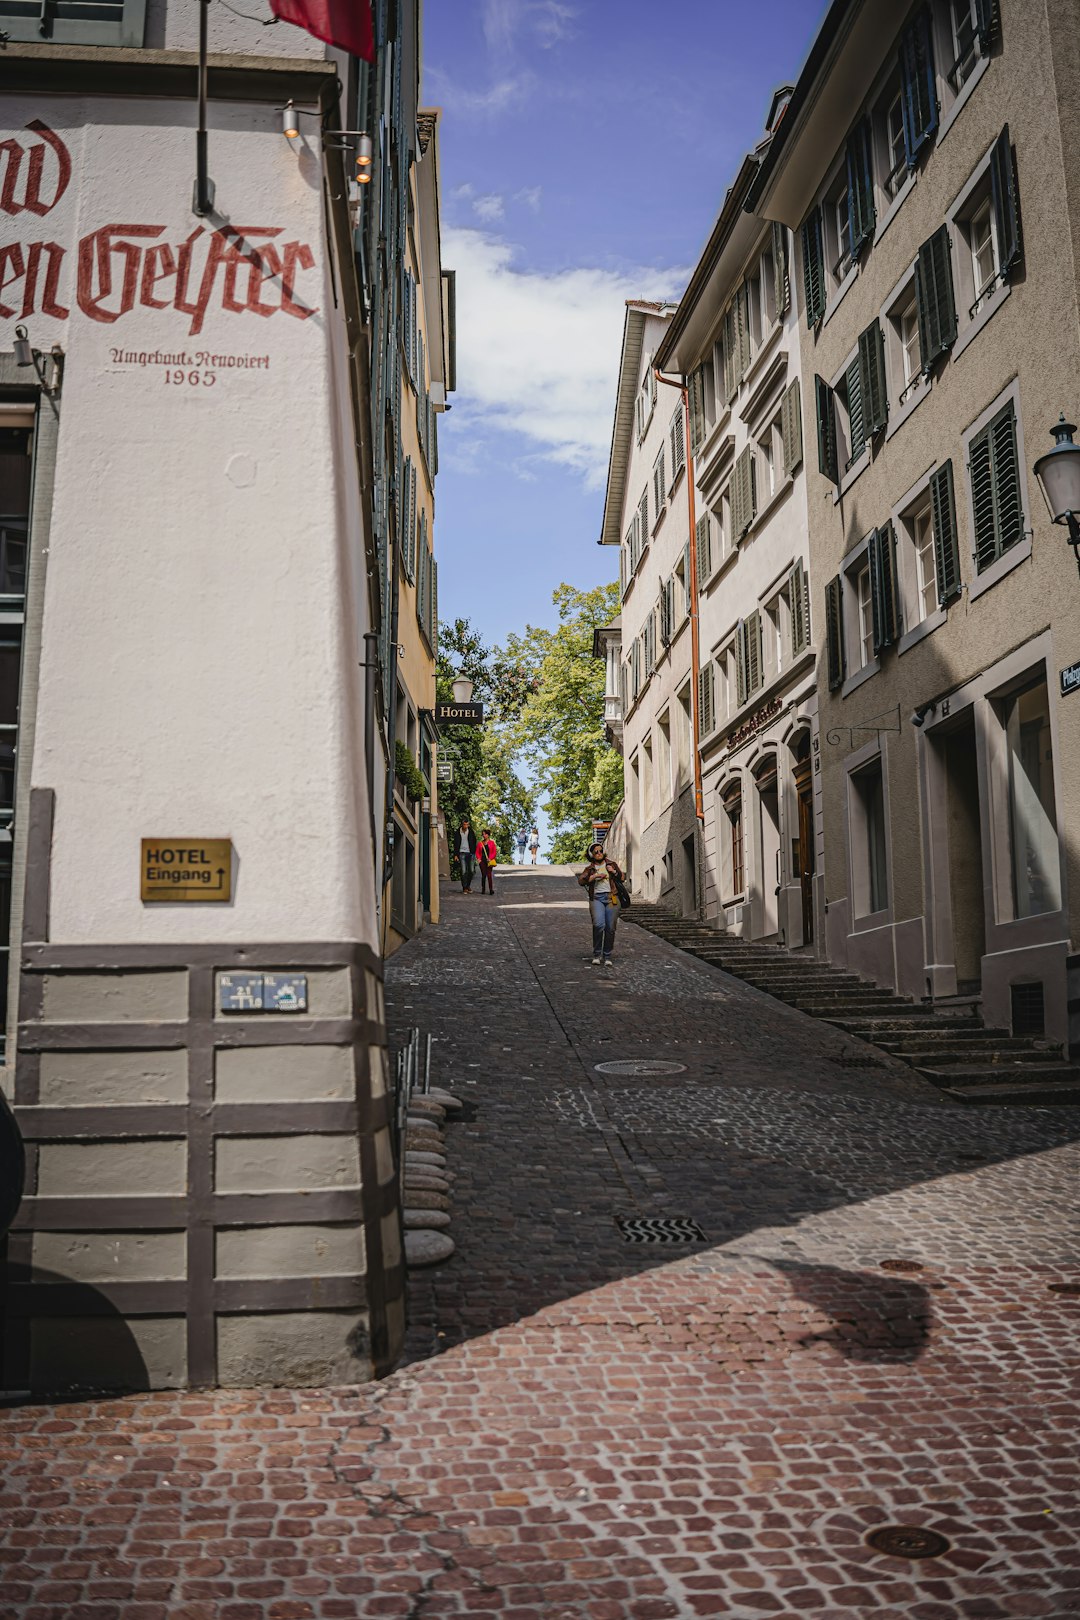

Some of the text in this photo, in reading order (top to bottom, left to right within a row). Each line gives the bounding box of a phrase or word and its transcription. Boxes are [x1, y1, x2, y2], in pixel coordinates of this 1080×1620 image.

[109, 348, 186, 367] Umgebaut
[195, 351, 270, 369] Renoviert
[164, 370, 216, 387] 1965
[146, 849, 211, 864] HOTEL
[146, 867, 211, 883] Eingang
